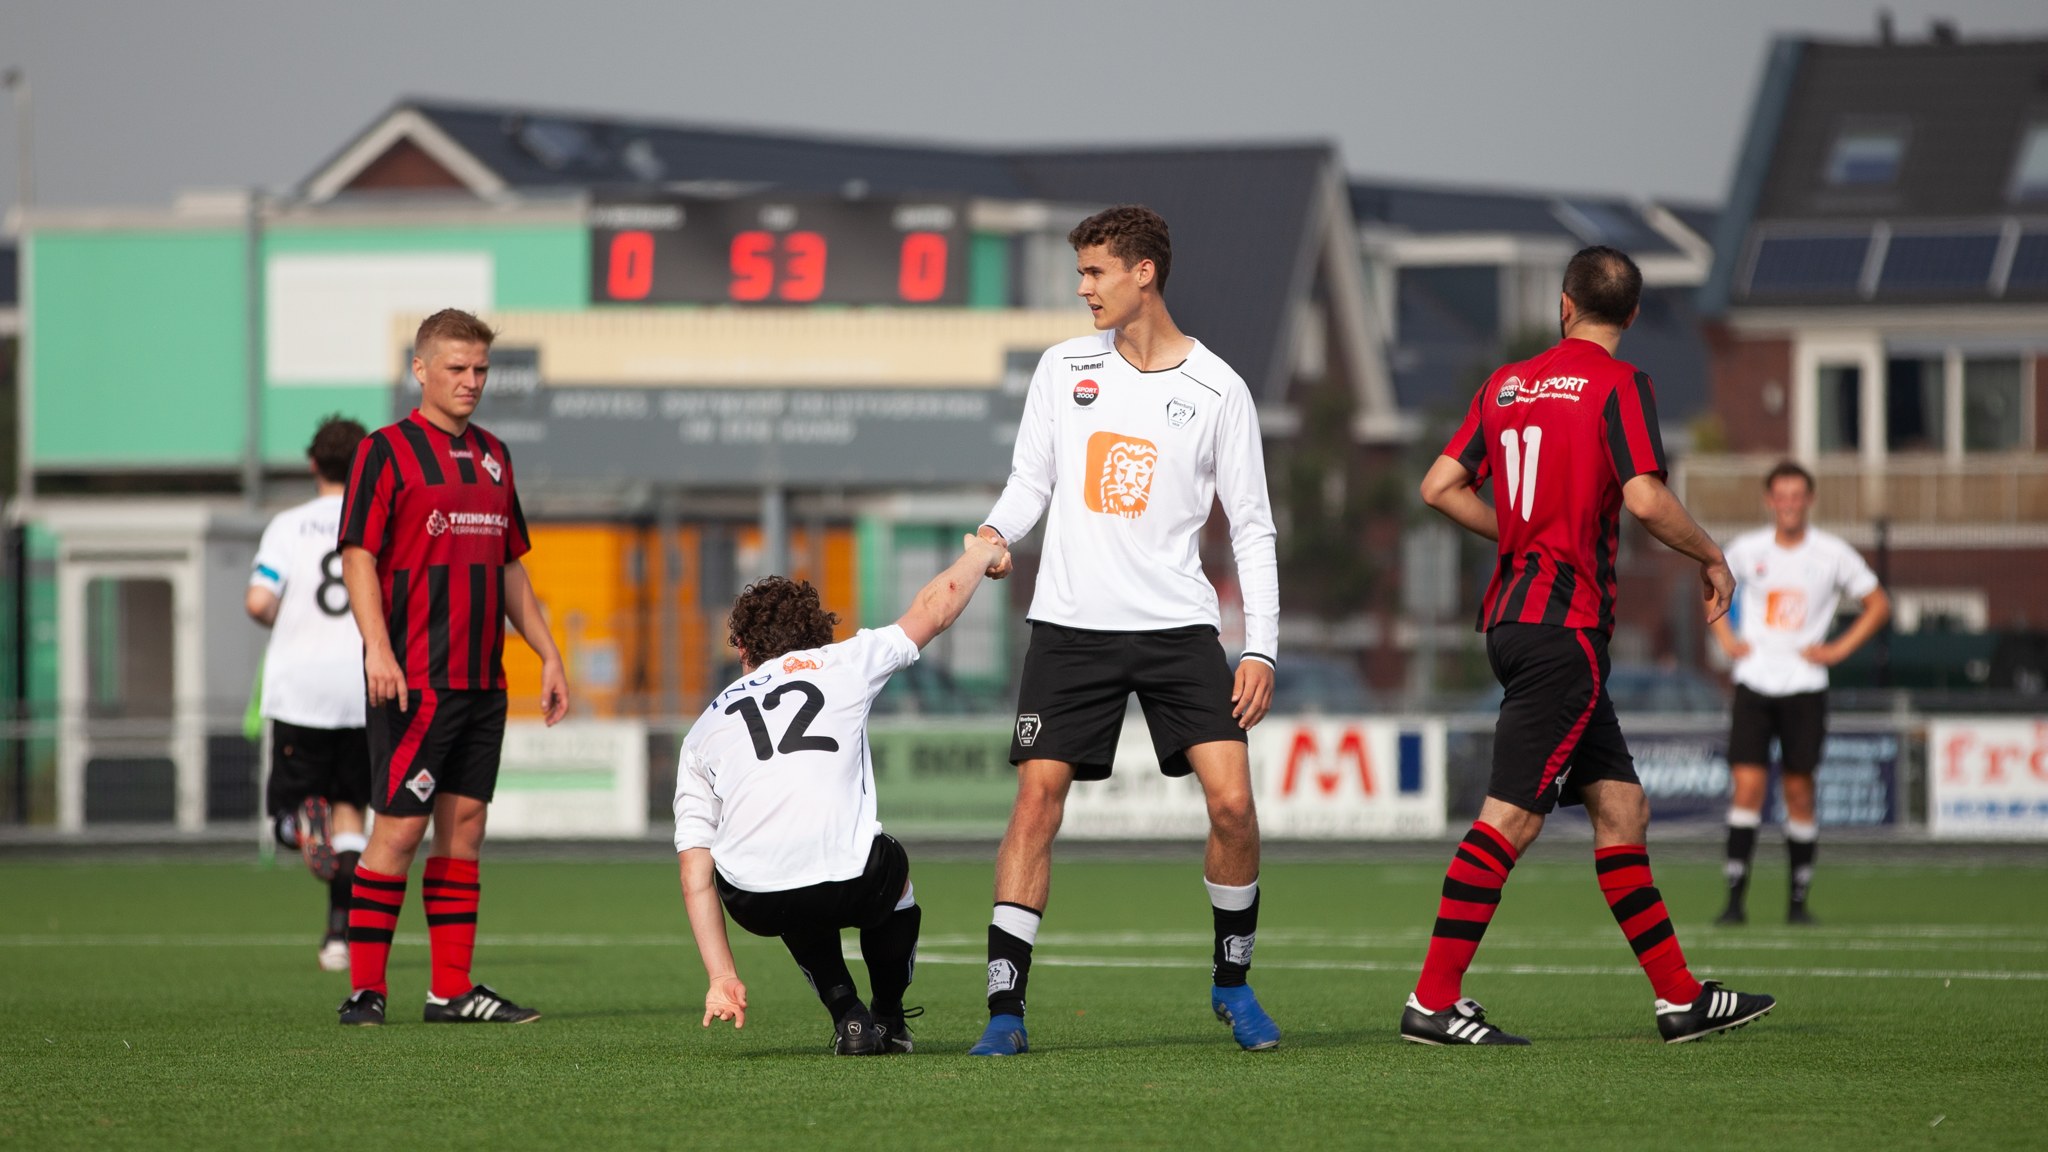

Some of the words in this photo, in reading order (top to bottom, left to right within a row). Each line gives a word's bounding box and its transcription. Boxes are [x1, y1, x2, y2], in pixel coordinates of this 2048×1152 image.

[607, 229, 656, 301] 0
[728, 229, 828, 302] 53
[898, 230, 948, 302] 0
[1071, 360, 1104, 371] hummel
[1501, 426, 1543, 523] 11
[315, 550, 351, 617] 8
[724, 680, 840, 761] 12
